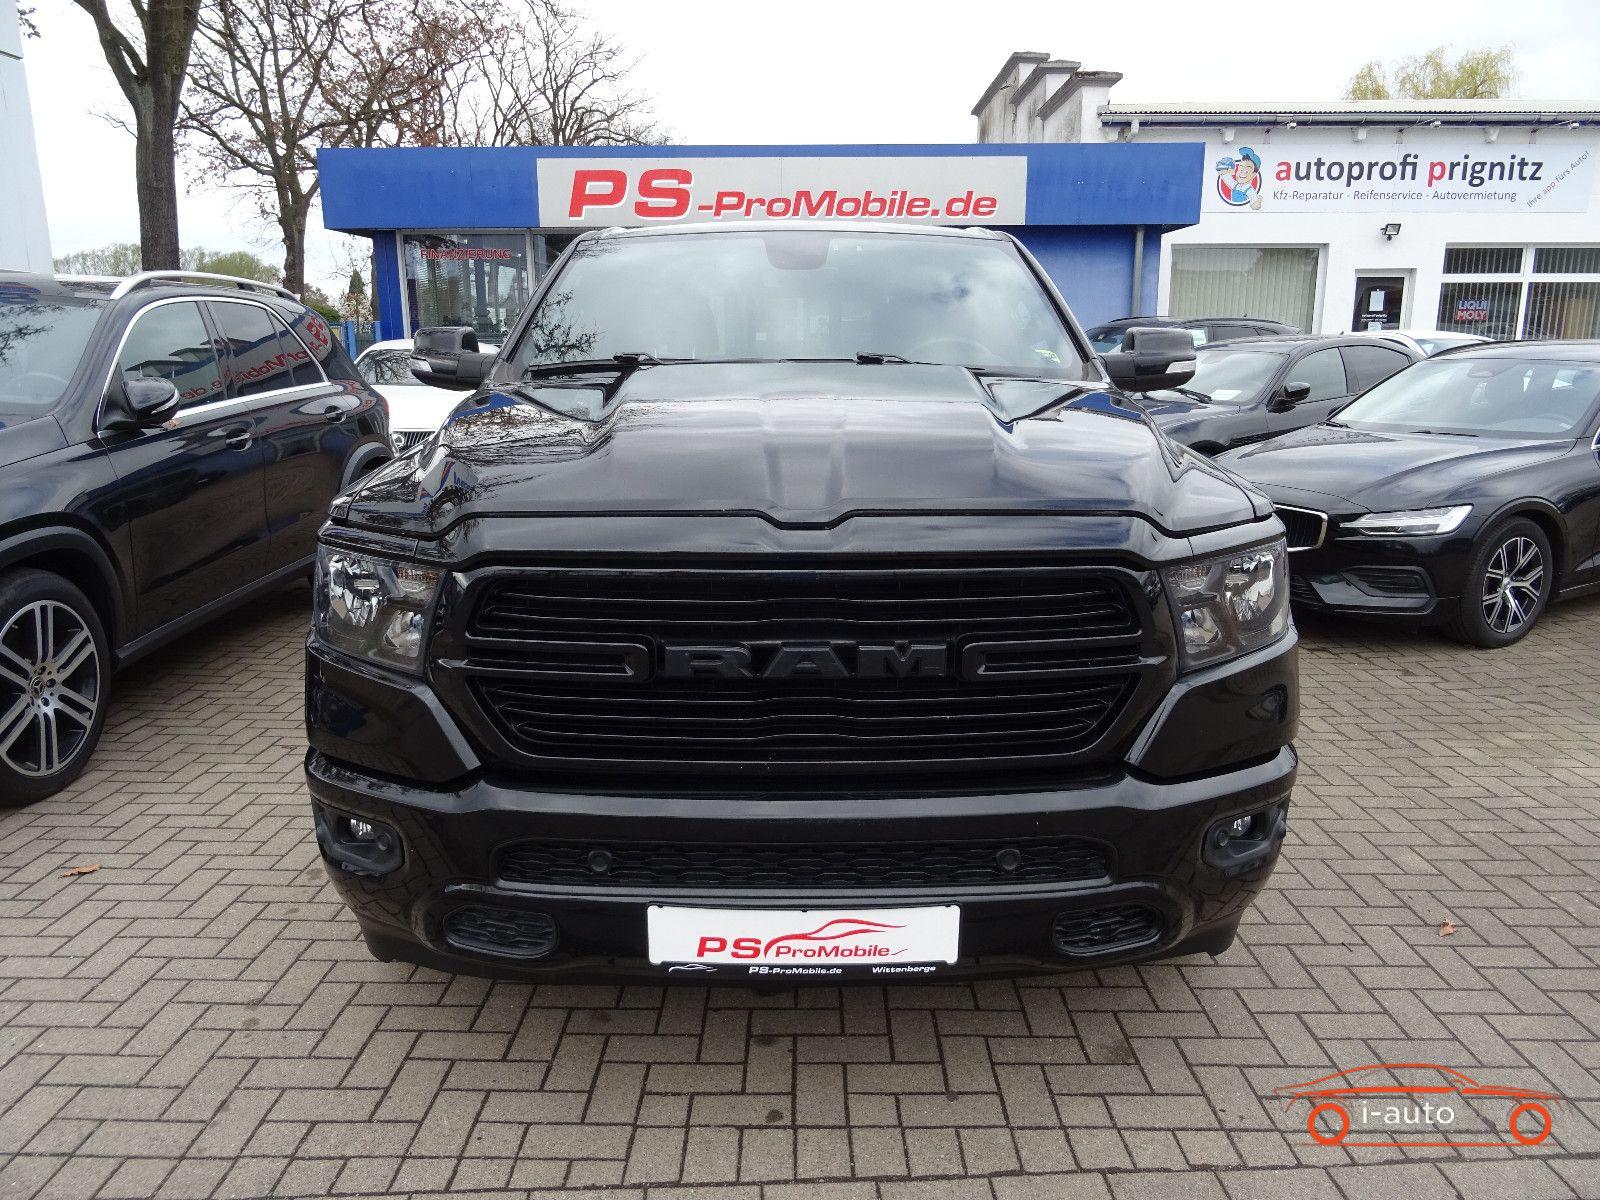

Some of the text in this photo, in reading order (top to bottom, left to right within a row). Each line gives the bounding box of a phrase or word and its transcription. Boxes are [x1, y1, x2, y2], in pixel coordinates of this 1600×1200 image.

[1276, 154, 1544, 188] autoprofi prignitz
[1542, 180, 1556, 195] app
[1273, 190, 1343, 202] Kfz-Reparatur
[1353, 190, 1422, 200] Reifenservice
[1432, 190, 1517, 203] Autovermietung
[420, 248, 513, 261] FINANZIERUNG
[1458, 300, 1488, 310] LIQUI
[1457, 310, 1488, 320] MOLY
[664, 645, 948, 679] RAM
[697, 936, 890, 959] PS ProMobile
[748, 964, 937, 975] PS-ProMobile.de Wittenberge
